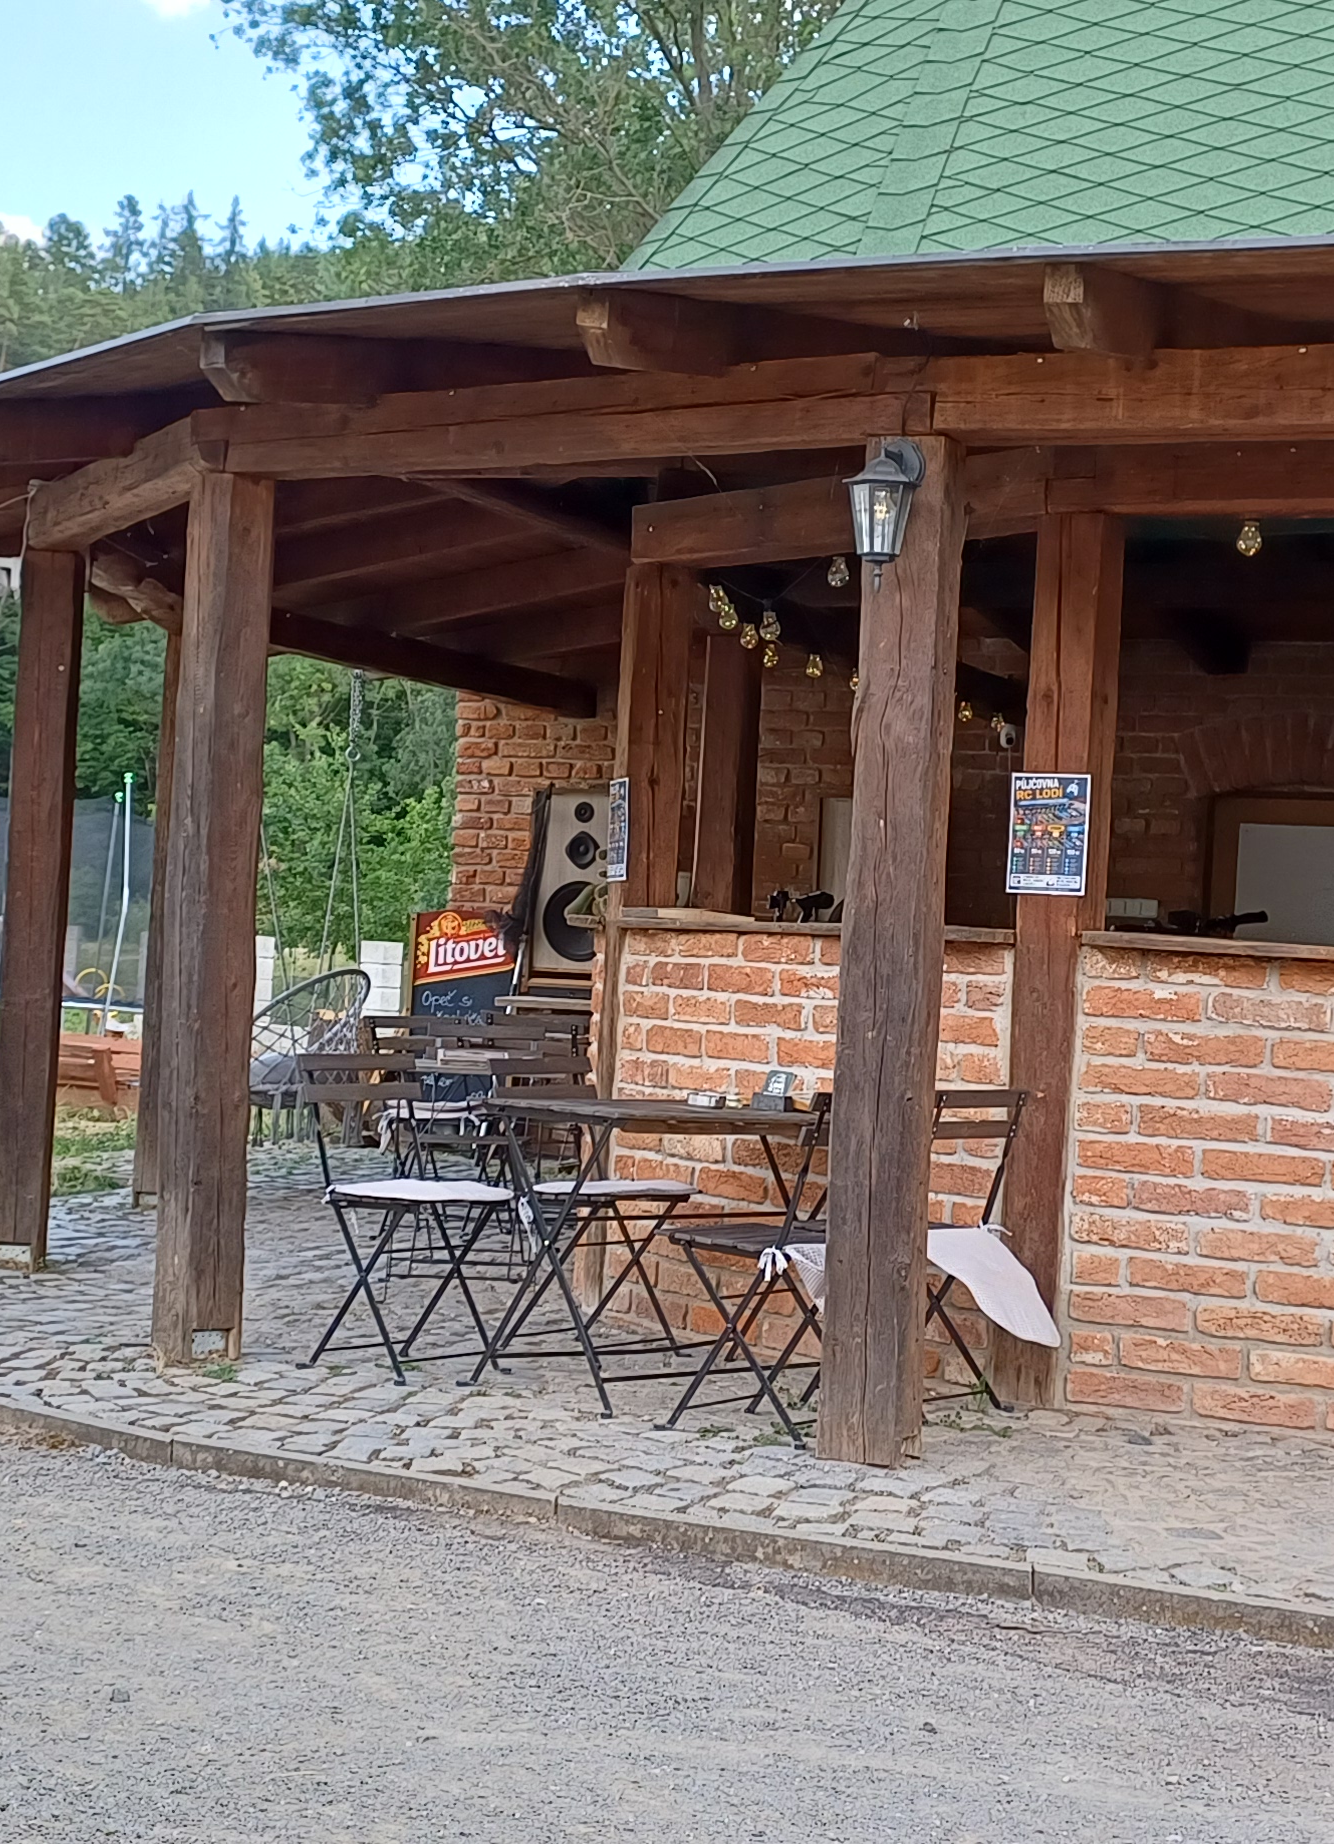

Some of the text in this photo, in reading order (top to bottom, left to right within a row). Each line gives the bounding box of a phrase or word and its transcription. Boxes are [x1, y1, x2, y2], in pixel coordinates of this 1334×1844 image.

[1016, 777, 1060, 790] PŮJČOVNA
[1016, 790, 1033, 800] RC
[427, 935, 507, 974] Litovel
